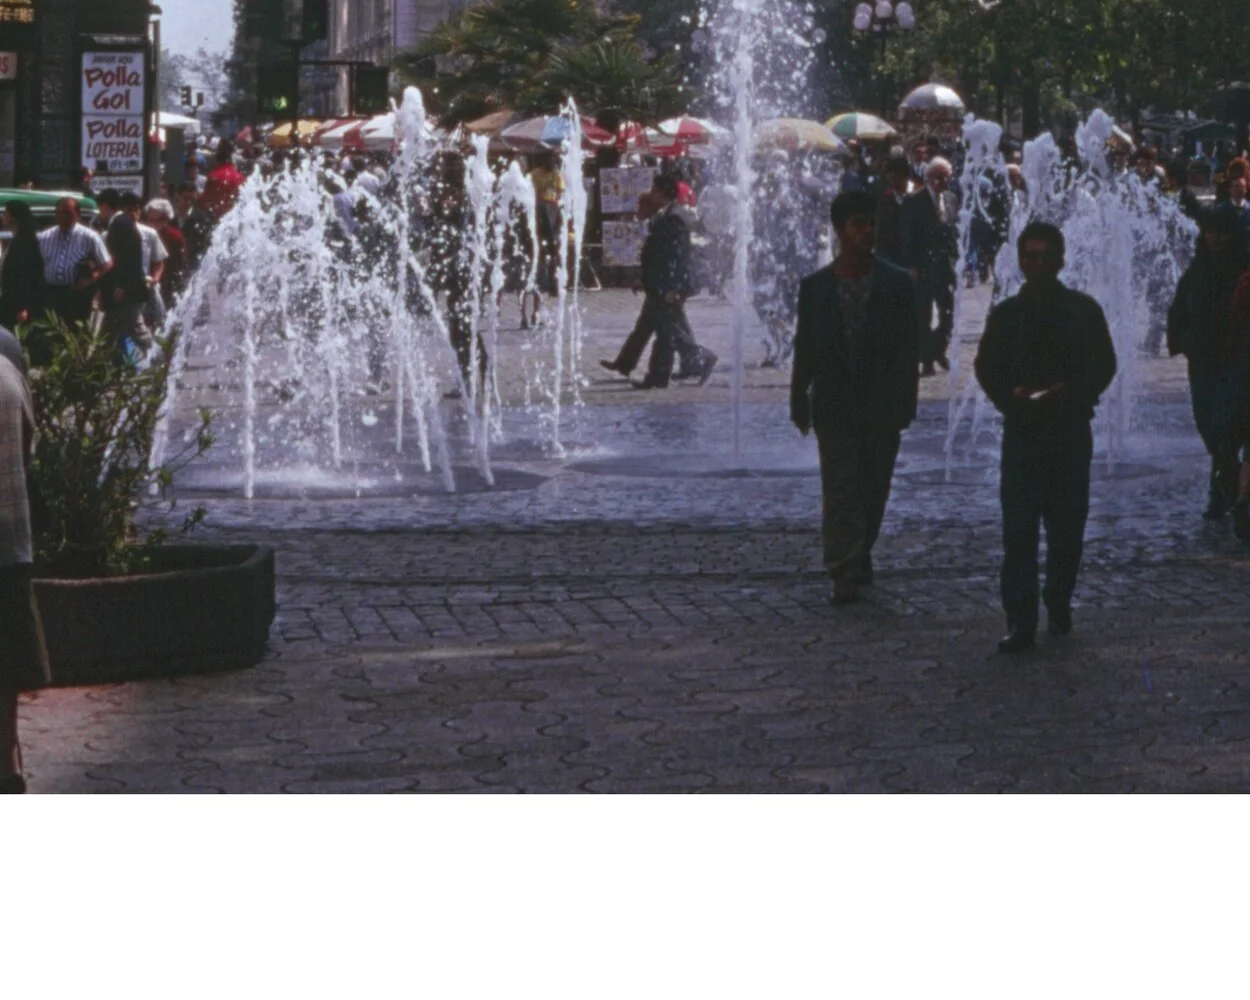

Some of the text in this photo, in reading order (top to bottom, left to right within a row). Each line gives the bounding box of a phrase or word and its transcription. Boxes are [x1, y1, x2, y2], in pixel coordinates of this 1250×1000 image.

[85, 66, 141, 88] Polla
[93, 89, 131, 110] Gol
[86, 119, 141, 139] Polla
[86, 142, 139, 158] LOTERIA
